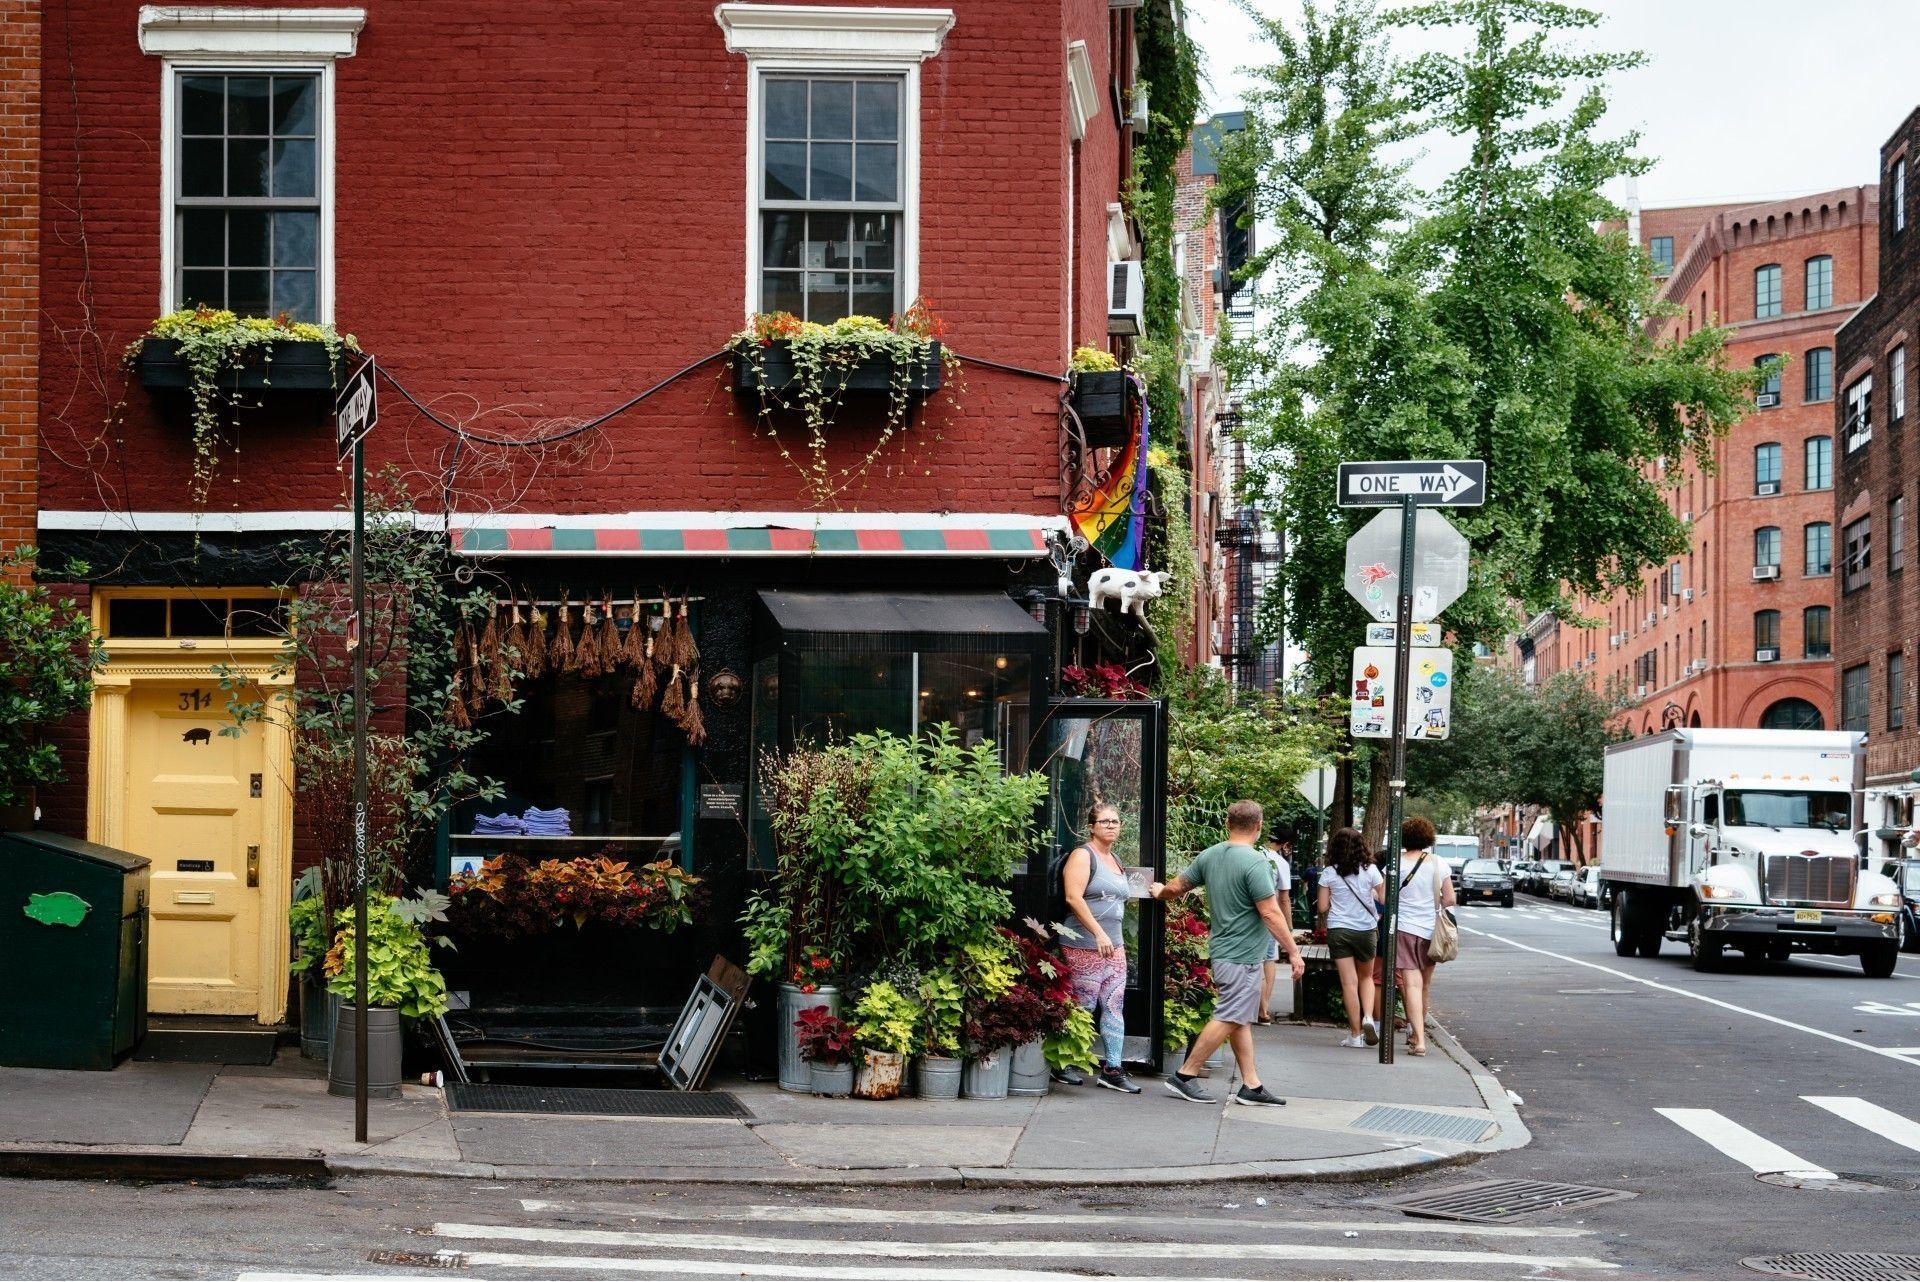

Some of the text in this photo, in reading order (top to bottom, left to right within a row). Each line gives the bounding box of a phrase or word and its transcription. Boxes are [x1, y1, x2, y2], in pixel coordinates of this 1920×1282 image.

[341, 384, 368, 436] ONE WAY
[1359, 475, 1462, 493] ONE WAY
[178, 688, 212, 711] 314
[462, 861, 476, 877] A
